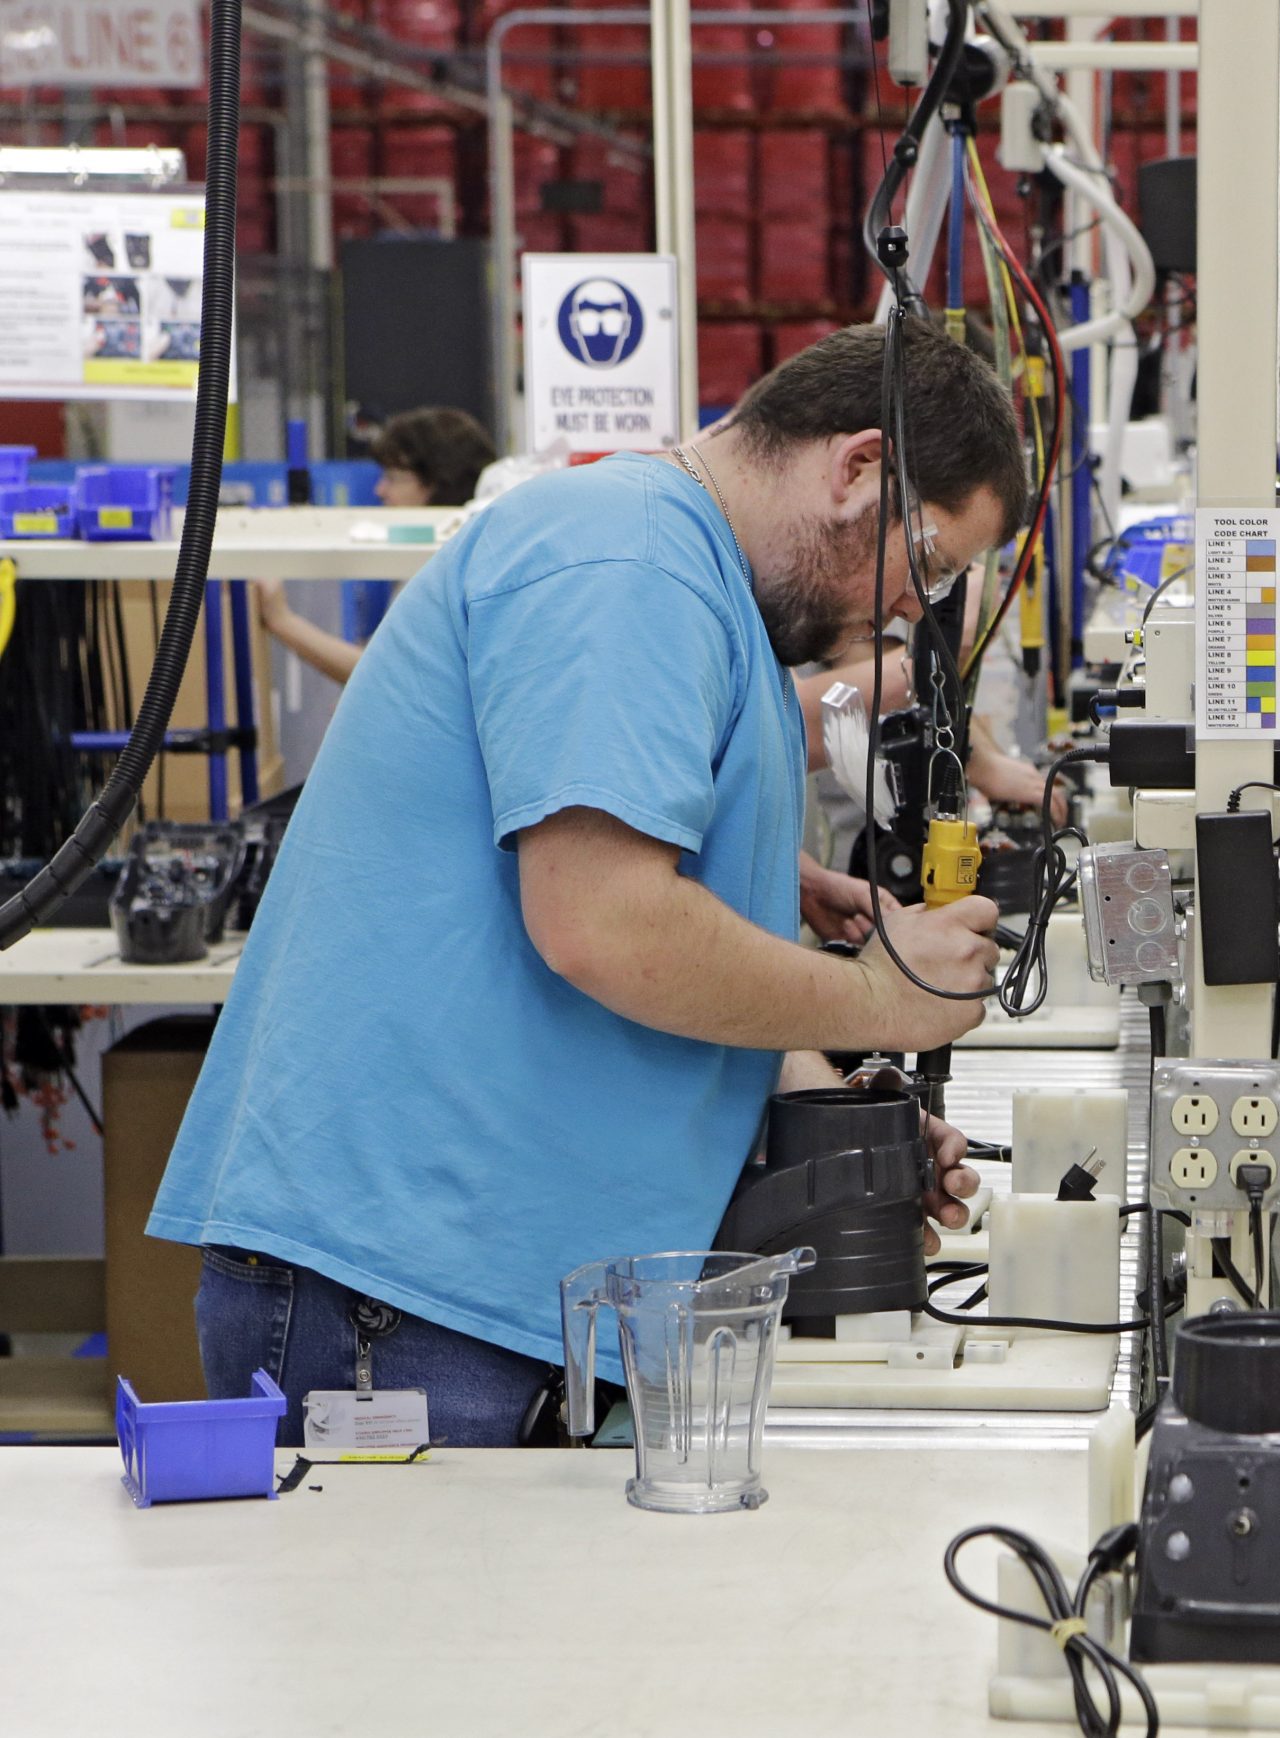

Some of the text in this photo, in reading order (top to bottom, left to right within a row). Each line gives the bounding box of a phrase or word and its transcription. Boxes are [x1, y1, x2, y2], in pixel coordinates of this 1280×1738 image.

[60, 8, 159, 73] LINE
[165, 10, 190, 74] 6
[550, 386, 654, 408] EYE PROTECTION
[555, 412, 651, 433] MUST BE WORN
